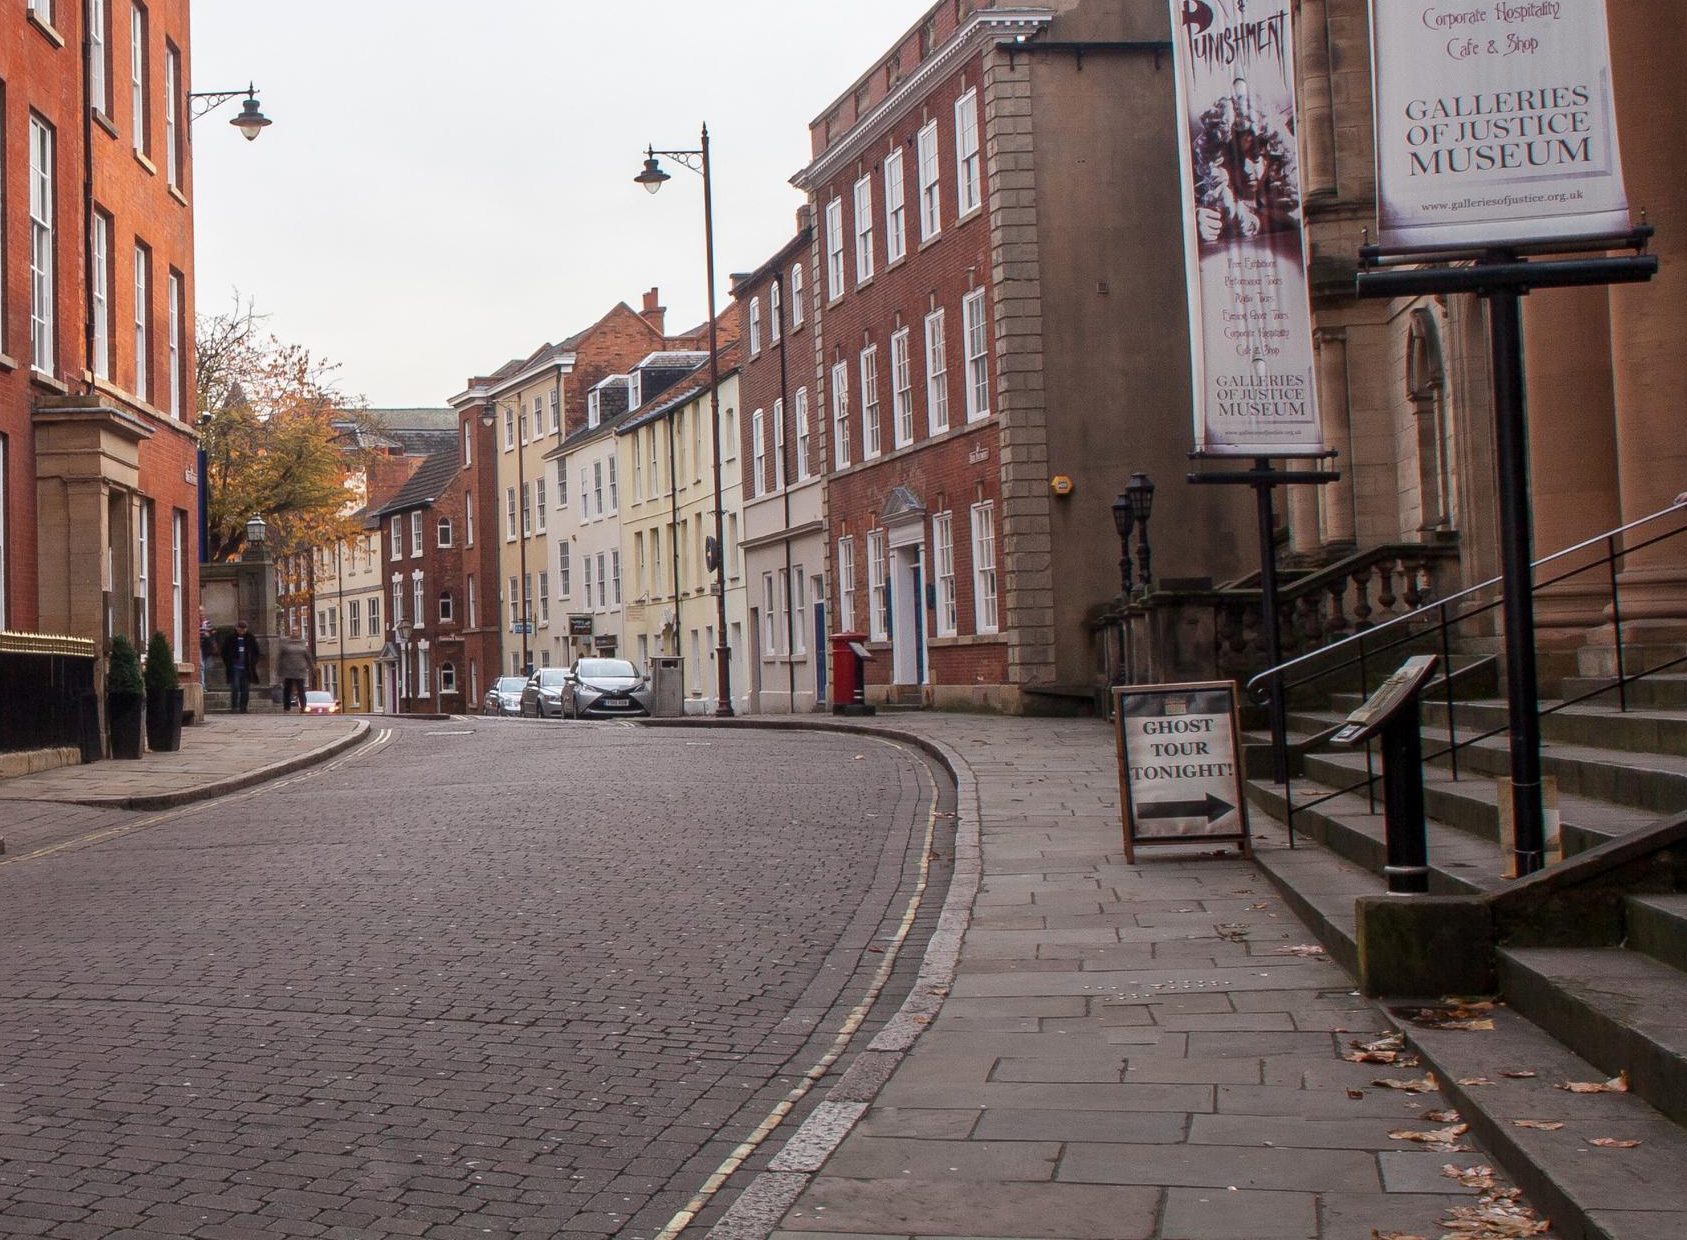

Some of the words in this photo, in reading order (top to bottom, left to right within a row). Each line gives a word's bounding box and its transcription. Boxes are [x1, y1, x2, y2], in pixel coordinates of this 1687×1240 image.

[1422, 8, 1487, 30] Corporate
[1495, 1, 1560, 23] Hospitality
[1447, 38, 1479, 60] Cafe
[1487, 39, 1498, 54] &
[1503, 33, 1538, 56] Shop
[1405, 85, 1589, 121] GALLERIES
[1406, 123, 1449, 146] OF
[1455, 111, 1590, 143] JUSTICE
[1409, 136, 1592, 176] MUSEUM
[1421, 190, 1584, 211] www.galleriesofjustice.org.uk
[1216, 374, 1304, 388] GALLERIES
[1217, 389, 1238, 401] OF
[1241, 388, 1305, 401] JUSTICE
[1218, 402, 1306, 417] MUSEUM
[1143, 719, 1214, 735] GHOST
[1150, 742, 1209, 757] TOUR
[1131, 763, 1233, 780] TONIGHT!
